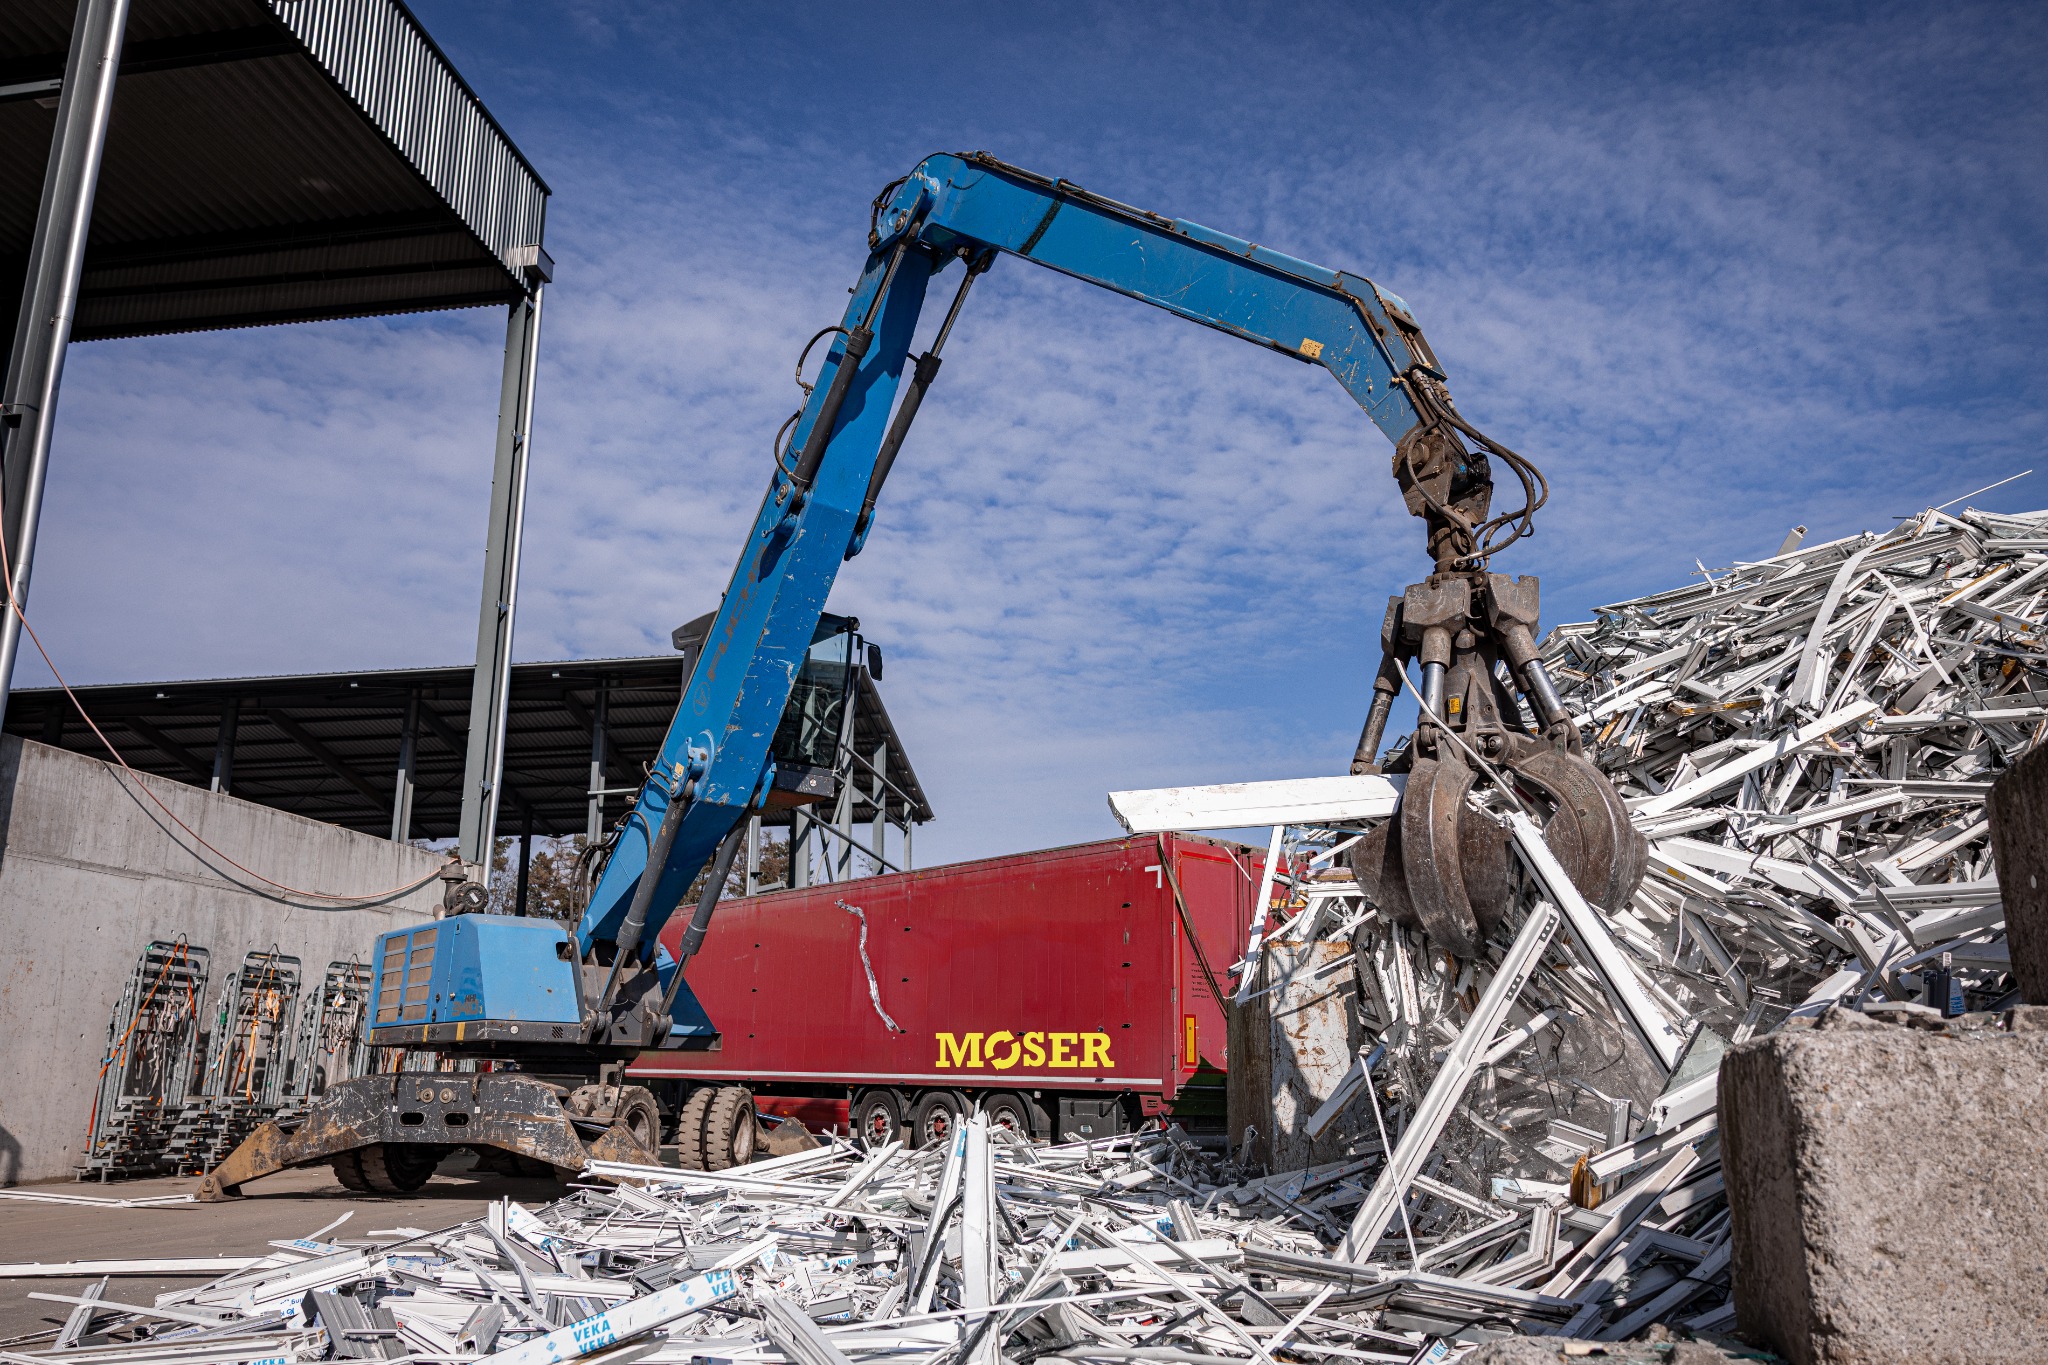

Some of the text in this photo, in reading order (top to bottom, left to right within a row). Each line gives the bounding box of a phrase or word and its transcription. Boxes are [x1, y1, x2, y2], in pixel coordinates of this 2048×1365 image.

[936, 1029, 1115, 1071] MOSER
[573, 1319, 611, 1342] VEKA
[579, 1333, 618, 1354] VEKA
